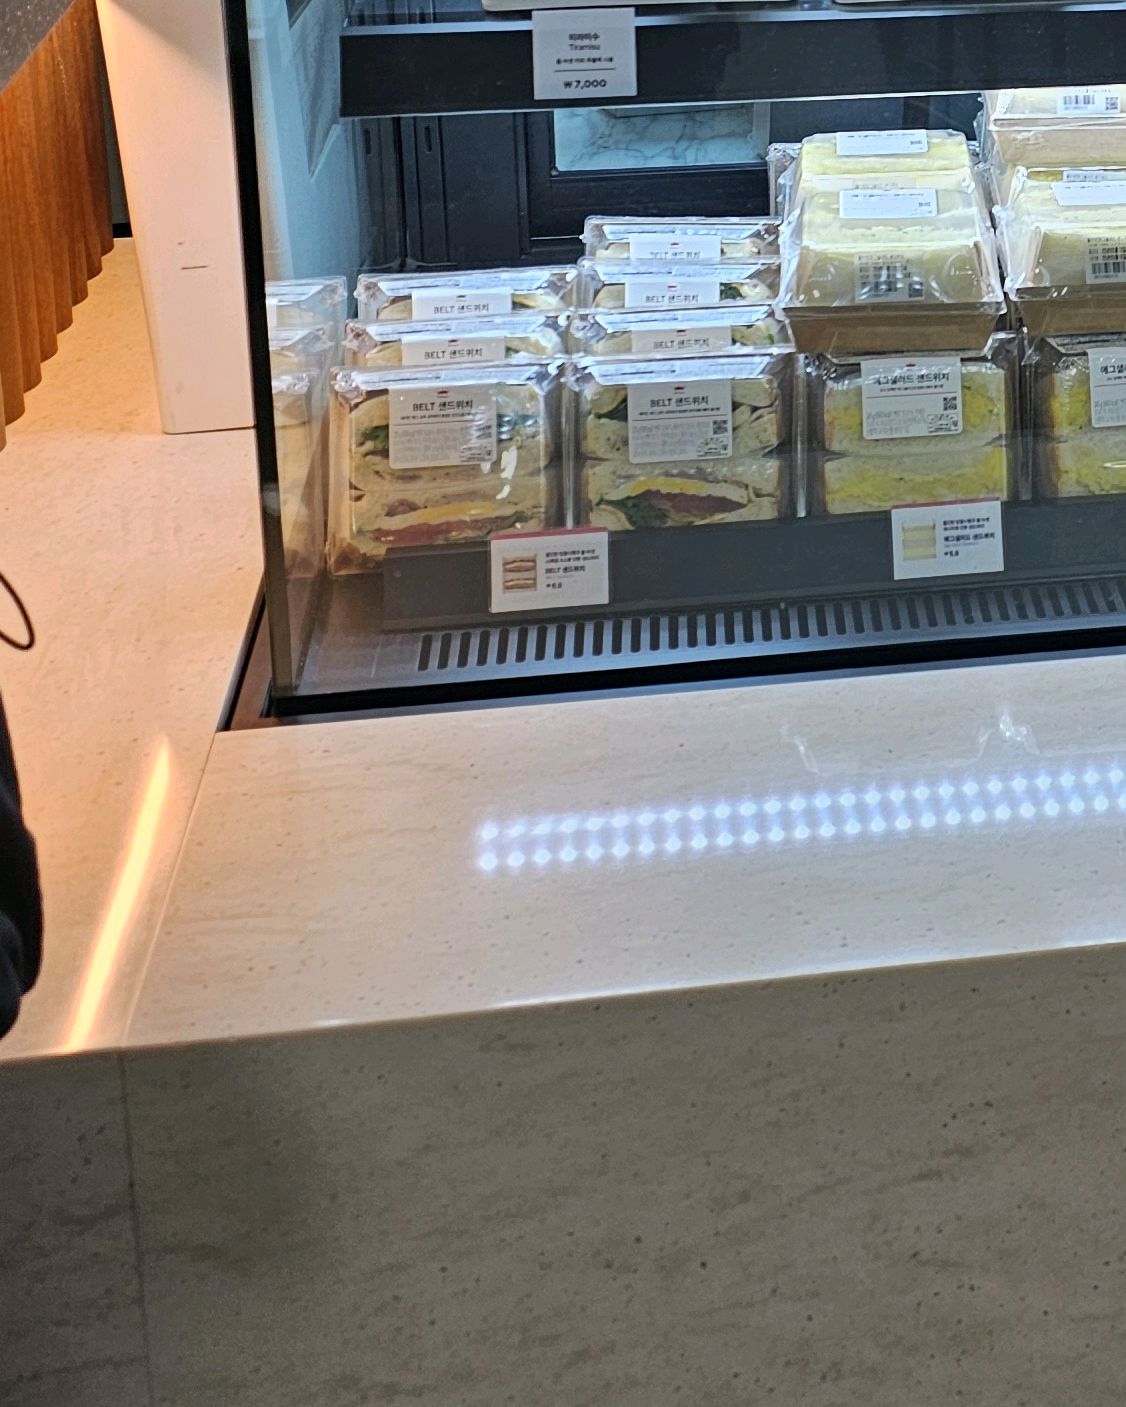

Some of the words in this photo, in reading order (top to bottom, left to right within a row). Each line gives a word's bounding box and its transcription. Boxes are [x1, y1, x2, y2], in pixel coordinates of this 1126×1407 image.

[575, 79, 607, 90] 7,000
[646, 295, 666, 304] BELT
[434, 306, 455, 314] BELT
[458, 303, 489, 314] 샌드위치
[425, 351, 446, 360] BELT
[449, 348, 483, 359] 샌드위치
[917, 372, 950, 384] 샌드위치
[413, 402, 435, 412] BELT
[438, 400, 473, 412] 샌드위치
[650, 398, 672, 408] BELT
[676, 395, 709, 407] 샌드위치
